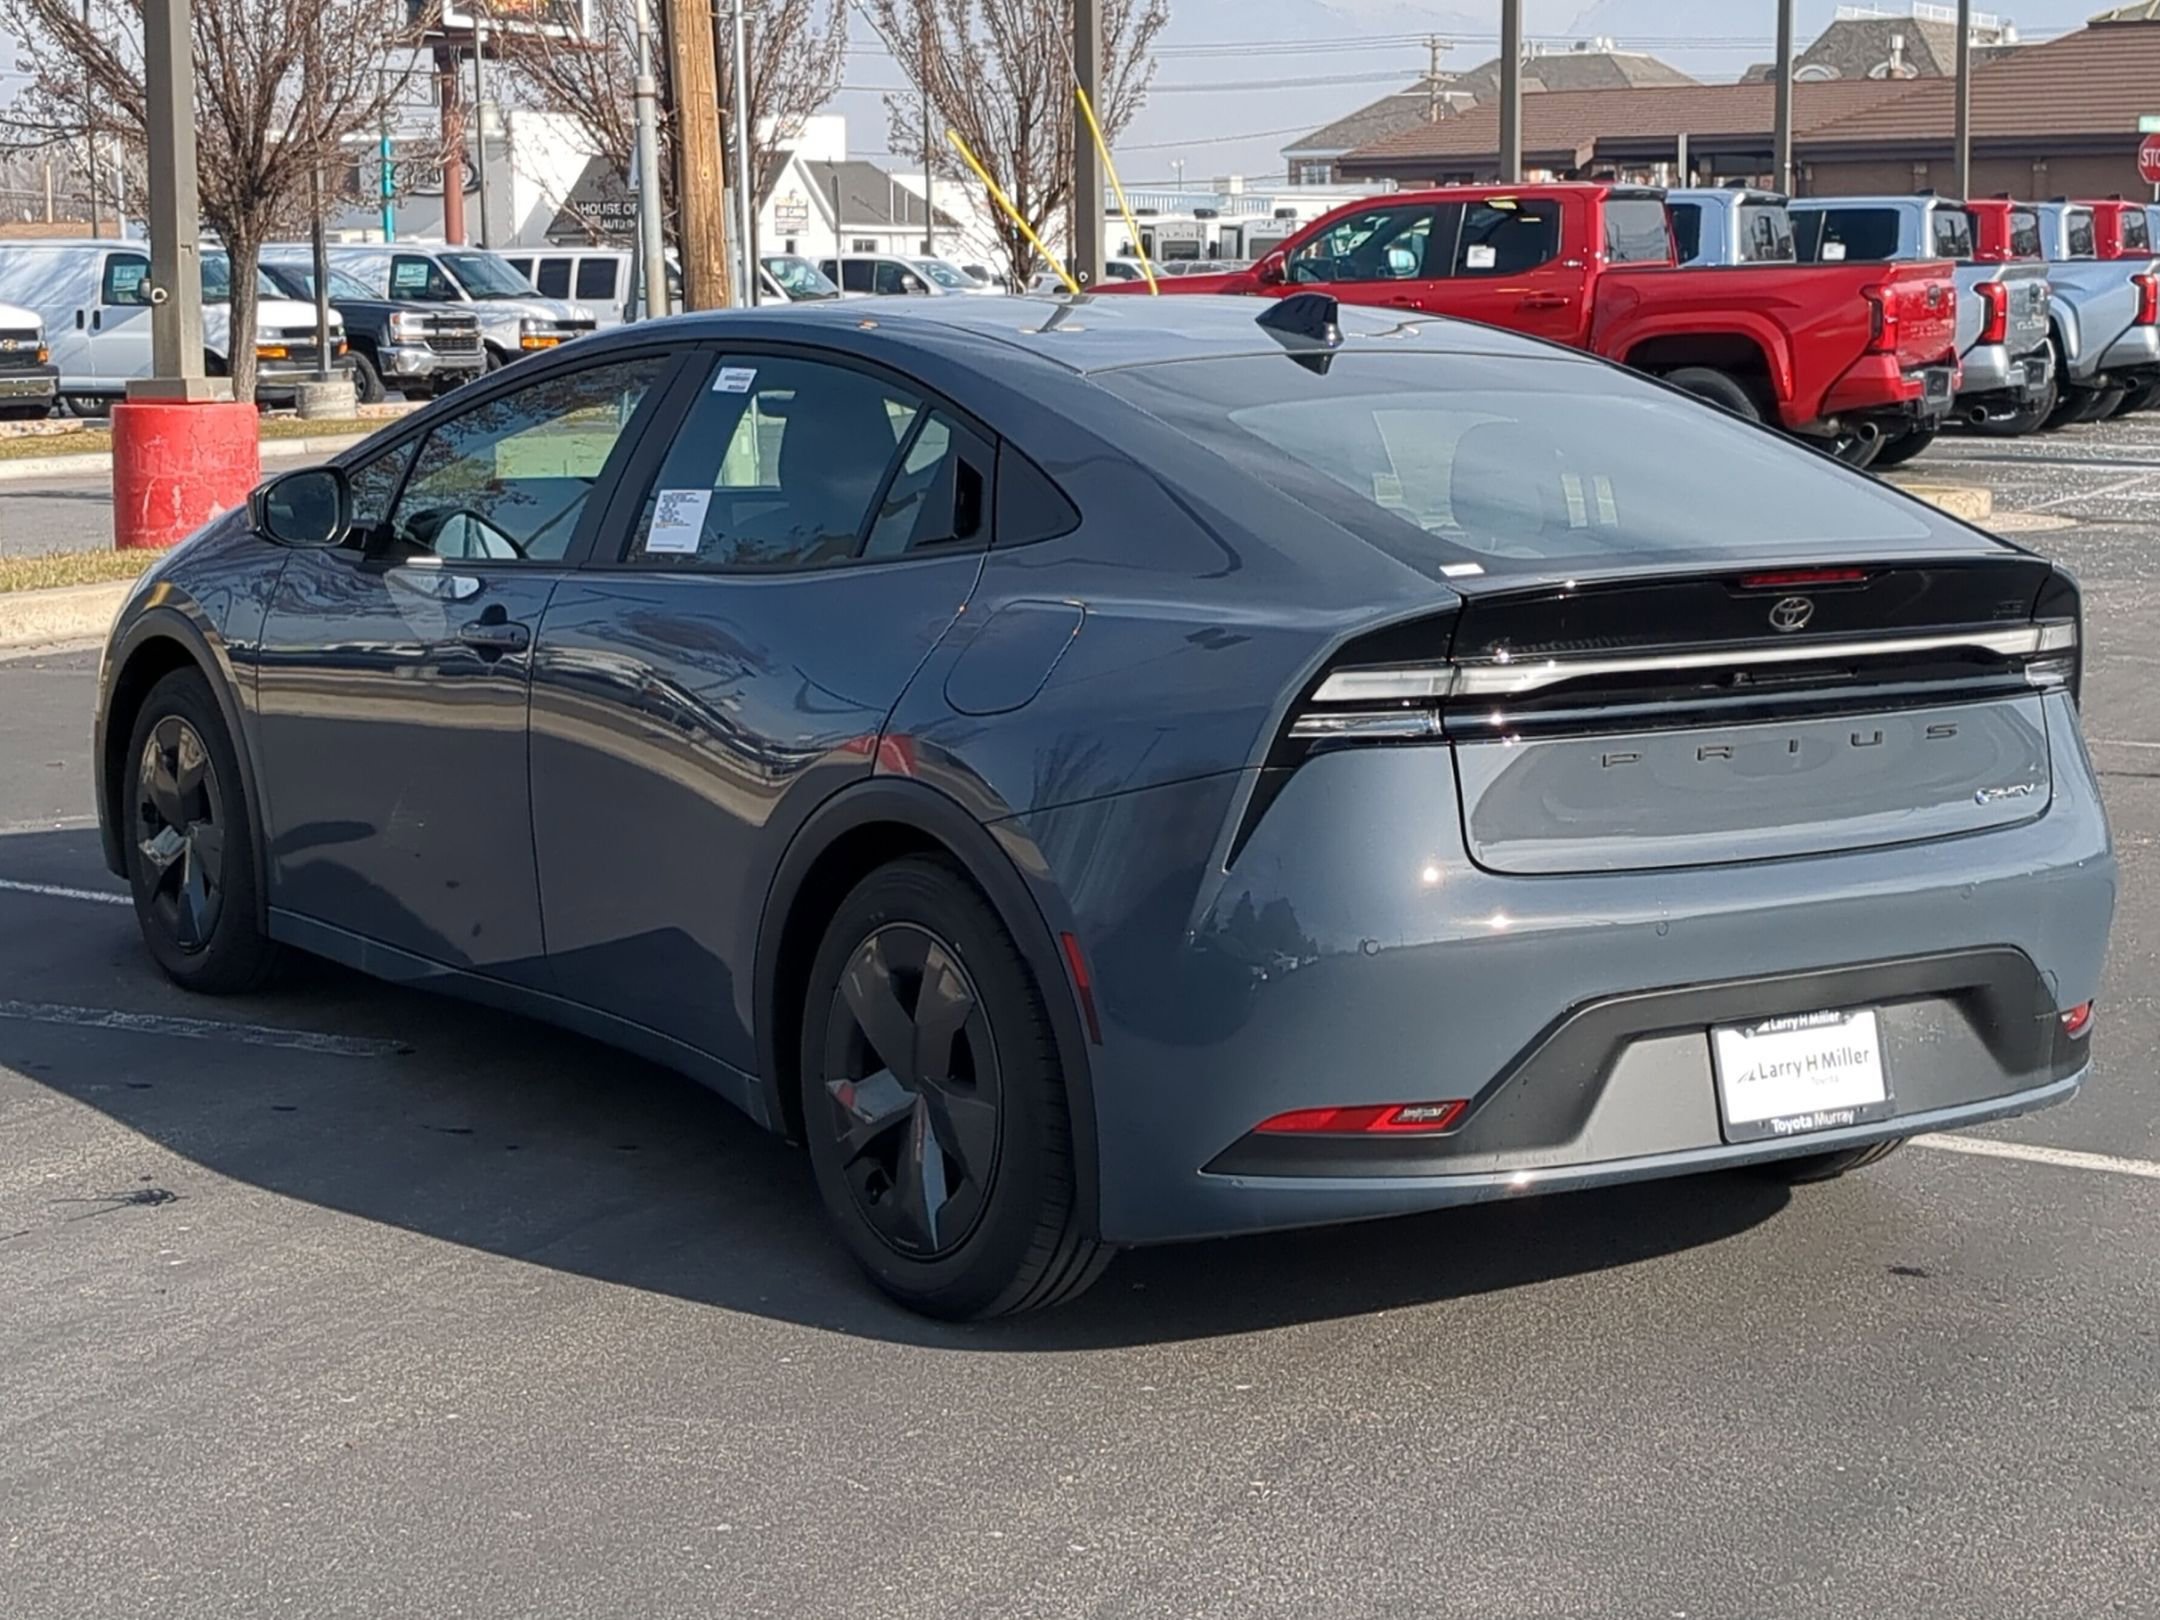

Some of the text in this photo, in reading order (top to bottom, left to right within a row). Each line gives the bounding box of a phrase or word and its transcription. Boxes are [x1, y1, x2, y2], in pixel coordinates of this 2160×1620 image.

[580, 203, 621, 215] HOUSE
[1602, 723, 1958, 768] PRIUS
[1770, 1009, 1841, 1031] Larry H Miller
[1758, 1045, 1869, 1080] Larry H Miller
[1771, 1109, 1855, 1135] Toyota Murray
